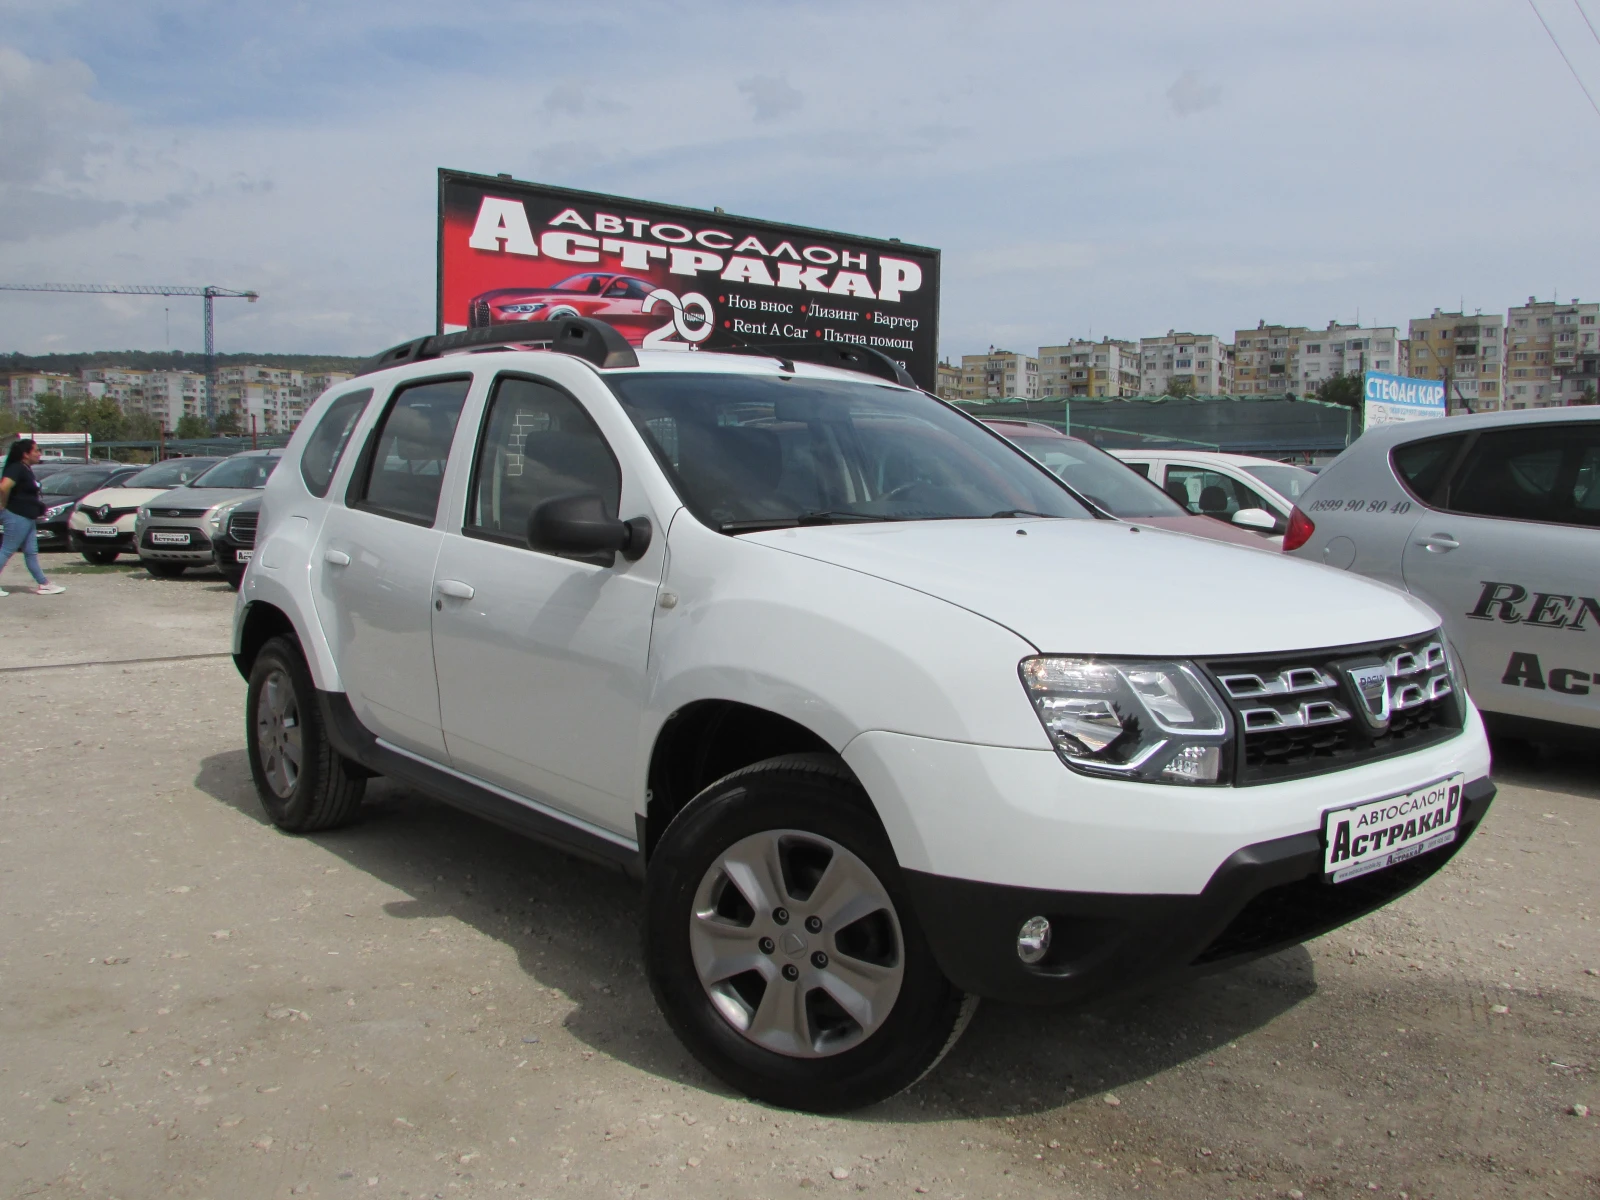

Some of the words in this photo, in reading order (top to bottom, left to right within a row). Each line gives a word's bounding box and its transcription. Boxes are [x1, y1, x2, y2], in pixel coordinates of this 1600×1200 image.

[548, 208, 867, 270] АВТОСАЛОН
[728, 294, 757, 310] Нов
[761, 301, 793, 313] внос
[808, 303, 859, 321] Лизинг
[874, 311, 919, 328] Бартер
[733, 319, 767, 336] Rent
[770, 324, 781, 337] A
[783, 325, 809, 339] Car
[823, 329, 866, 345] Пътна
[869, 337, 914, 350] помощ
[1366, 377, 1417, 403] СТЕФАН
[1418, 385, 1444, 405] КАР
[1309, 499, 1343, 512] 0899
[1344, 499, 1364, 512] 90
[1366, 500, 1387, 513] 80
[1390, 501, 1411, 514] 40
[1356, 787, 1446, 829] АВТОСАЛОН
[1330, 784, 1460, 864] АСТРАКАР
